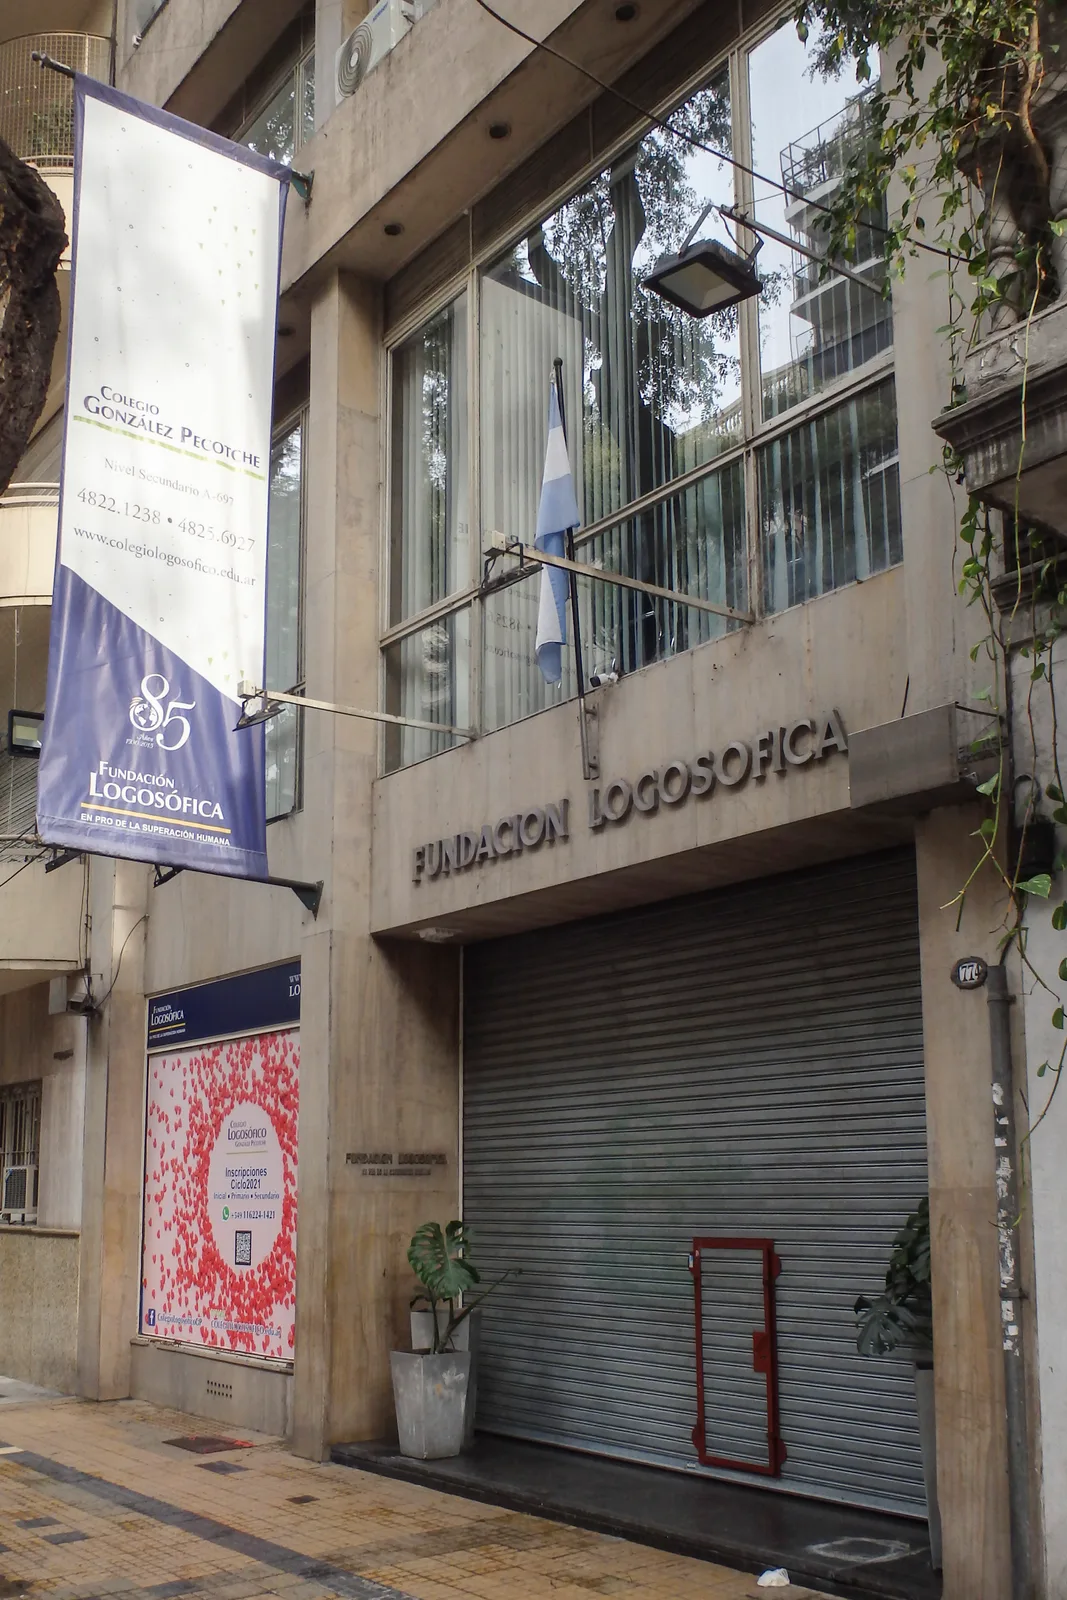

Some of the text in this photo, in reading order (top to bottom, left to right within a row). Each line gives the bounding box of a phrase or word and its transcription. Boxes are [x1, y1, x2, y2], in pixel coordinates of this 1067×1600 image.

[100, 385, 159, 415] COLEGIO
[83, 395, 261, 469] GONZÁLEZ PECOTCHE
[104, 457, 234, 507] Nivel Secundario A-697
[77, 488, 255, 553] 4822.1238 4825.6927
[73, 526, 256, 586] www.colegiologosofico.edu.ar
[129, 673, 196, 751] 85
[99, 760, 175, 788] FUNDACIÓN
[411, 706, 849, 882] FUNDACION LOGOSOFICA
[89, 772, 224, 820] LOGOSÓFICA
[80, 812, 230, 846] EN PRO DE LA SUPERACIÓN HUMANA
[151, 1010, 184, 1026] LOGOSÓFICA
[227, 1126, 267, 1140] LOGOSÓFICO
[225, 1166, 267, 1179] Inscripciones
[254, 1190, 279, 1199] Secundario
